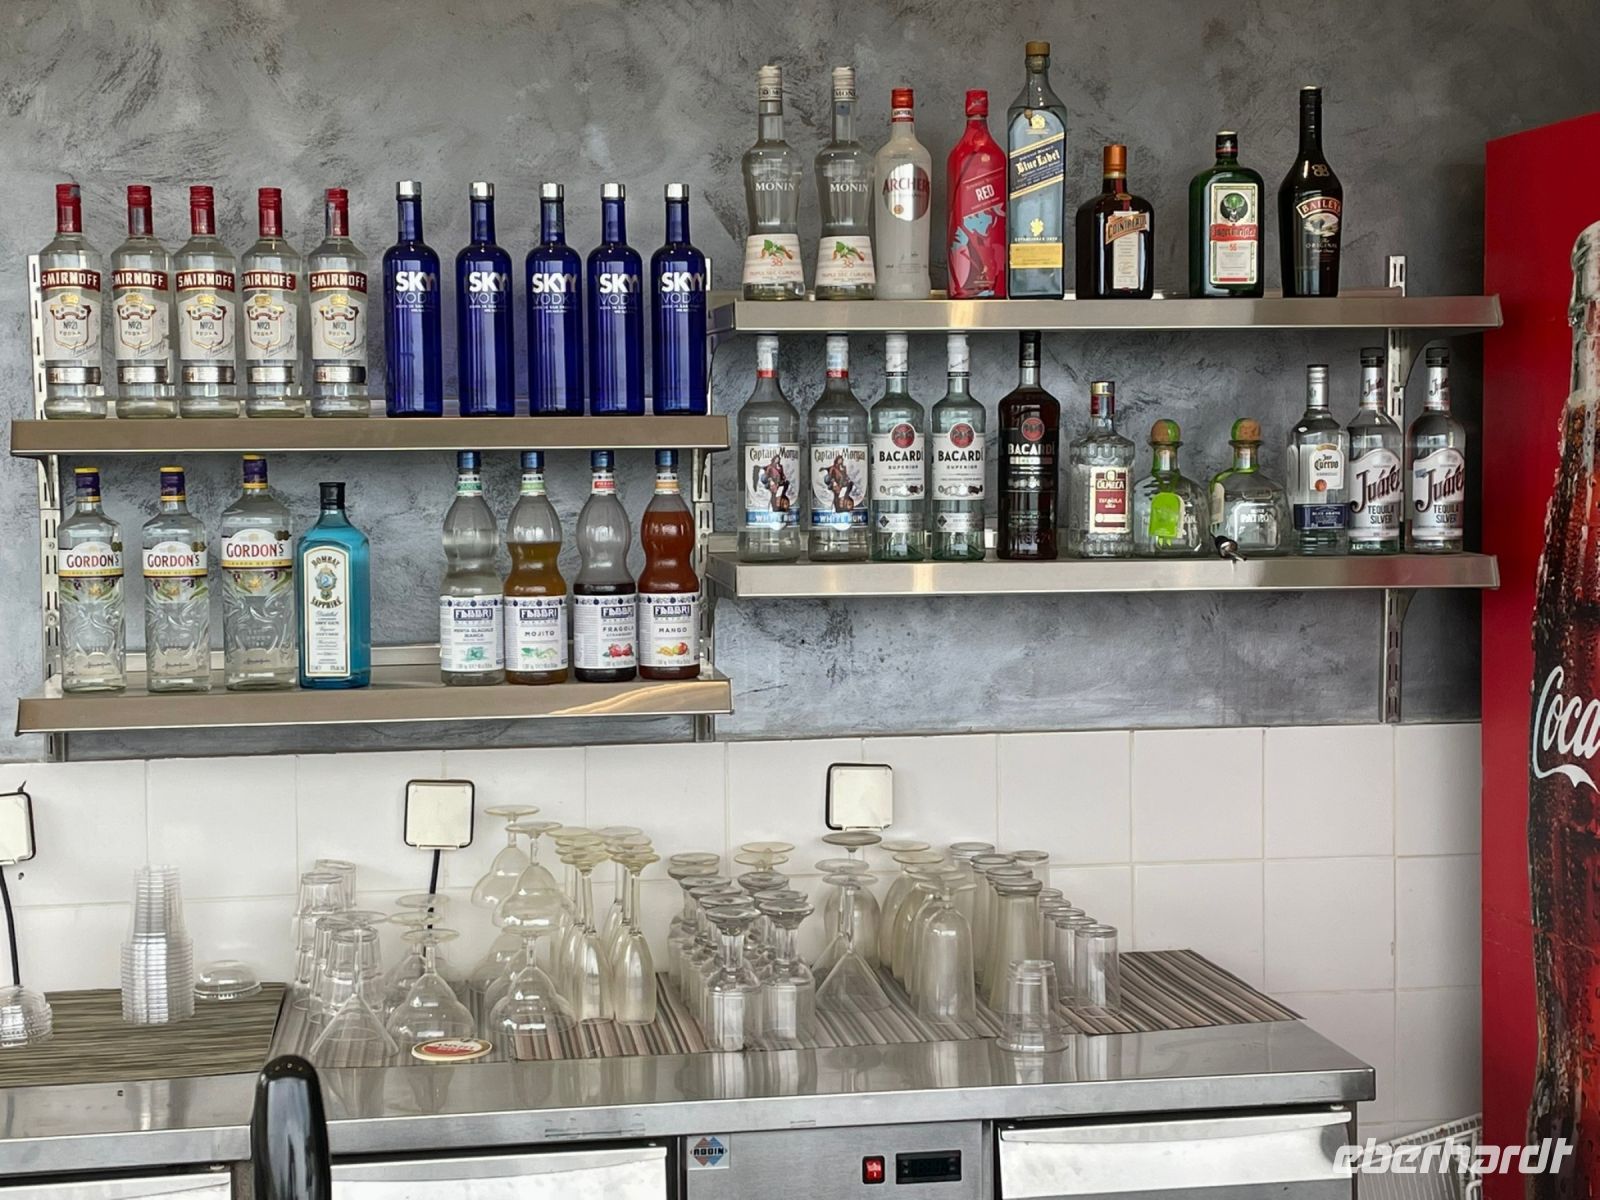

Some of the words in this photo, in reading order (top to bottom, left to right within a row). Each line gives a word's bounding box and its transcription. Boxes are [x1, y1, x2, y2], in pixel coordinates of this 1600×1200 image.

[1016, 158, 1037, 175] Blue
[1037, 149, 1061, 167] Label
[755, 182, 795, 191] MONIN
[830, 183, 869, 193] MONIN
[883, 178, 930, 196] ARCHER
[975, 184, 995, 202] RED
[771, 258, 783, 267] 38
[842, 259, 855, 268] 38
[42, 272, 98, 286] SMIRNOFF
[178, 272, 232, 288] SMIRNOFF
[312, 275, 365, 288] SMIRNOFF
[532, 272, 577, 294] SKYY
[661, 271, 705, 293] SKYY
[749, 448, 778, 462] Captain
[814, 449, 840, 462] Captain
[842, 449, 866, 462] Morgan
[1314, 460, 1339, 471] Cuervo
[1415, 465, 1464, 513] Juáre
[1368, 505, 1395, 514] TEQUILA
[1433, 505, 1458, 514] TEQUILA
[1370, 514, 1393, 524] SILVER
[1436, 514, 1457, 524] SILVER
[226, 542, 284, 557] GORDON'S
[66, 554, 119, 568] GORDON'S
[147, 554, 200, 568] GORDON'S
[311, 555, 341, 569] BOMBAY
[310, 596, 343, 609] SAPPHIRE
[455, 609, 492, 619] FABBRI
[521, 608, 557, 619] FABBRI
[603, 607, 634, 617] FABBR
[655, 606, 690, 616] FABBRI
[1532, 665, 1600, 794] Coca
